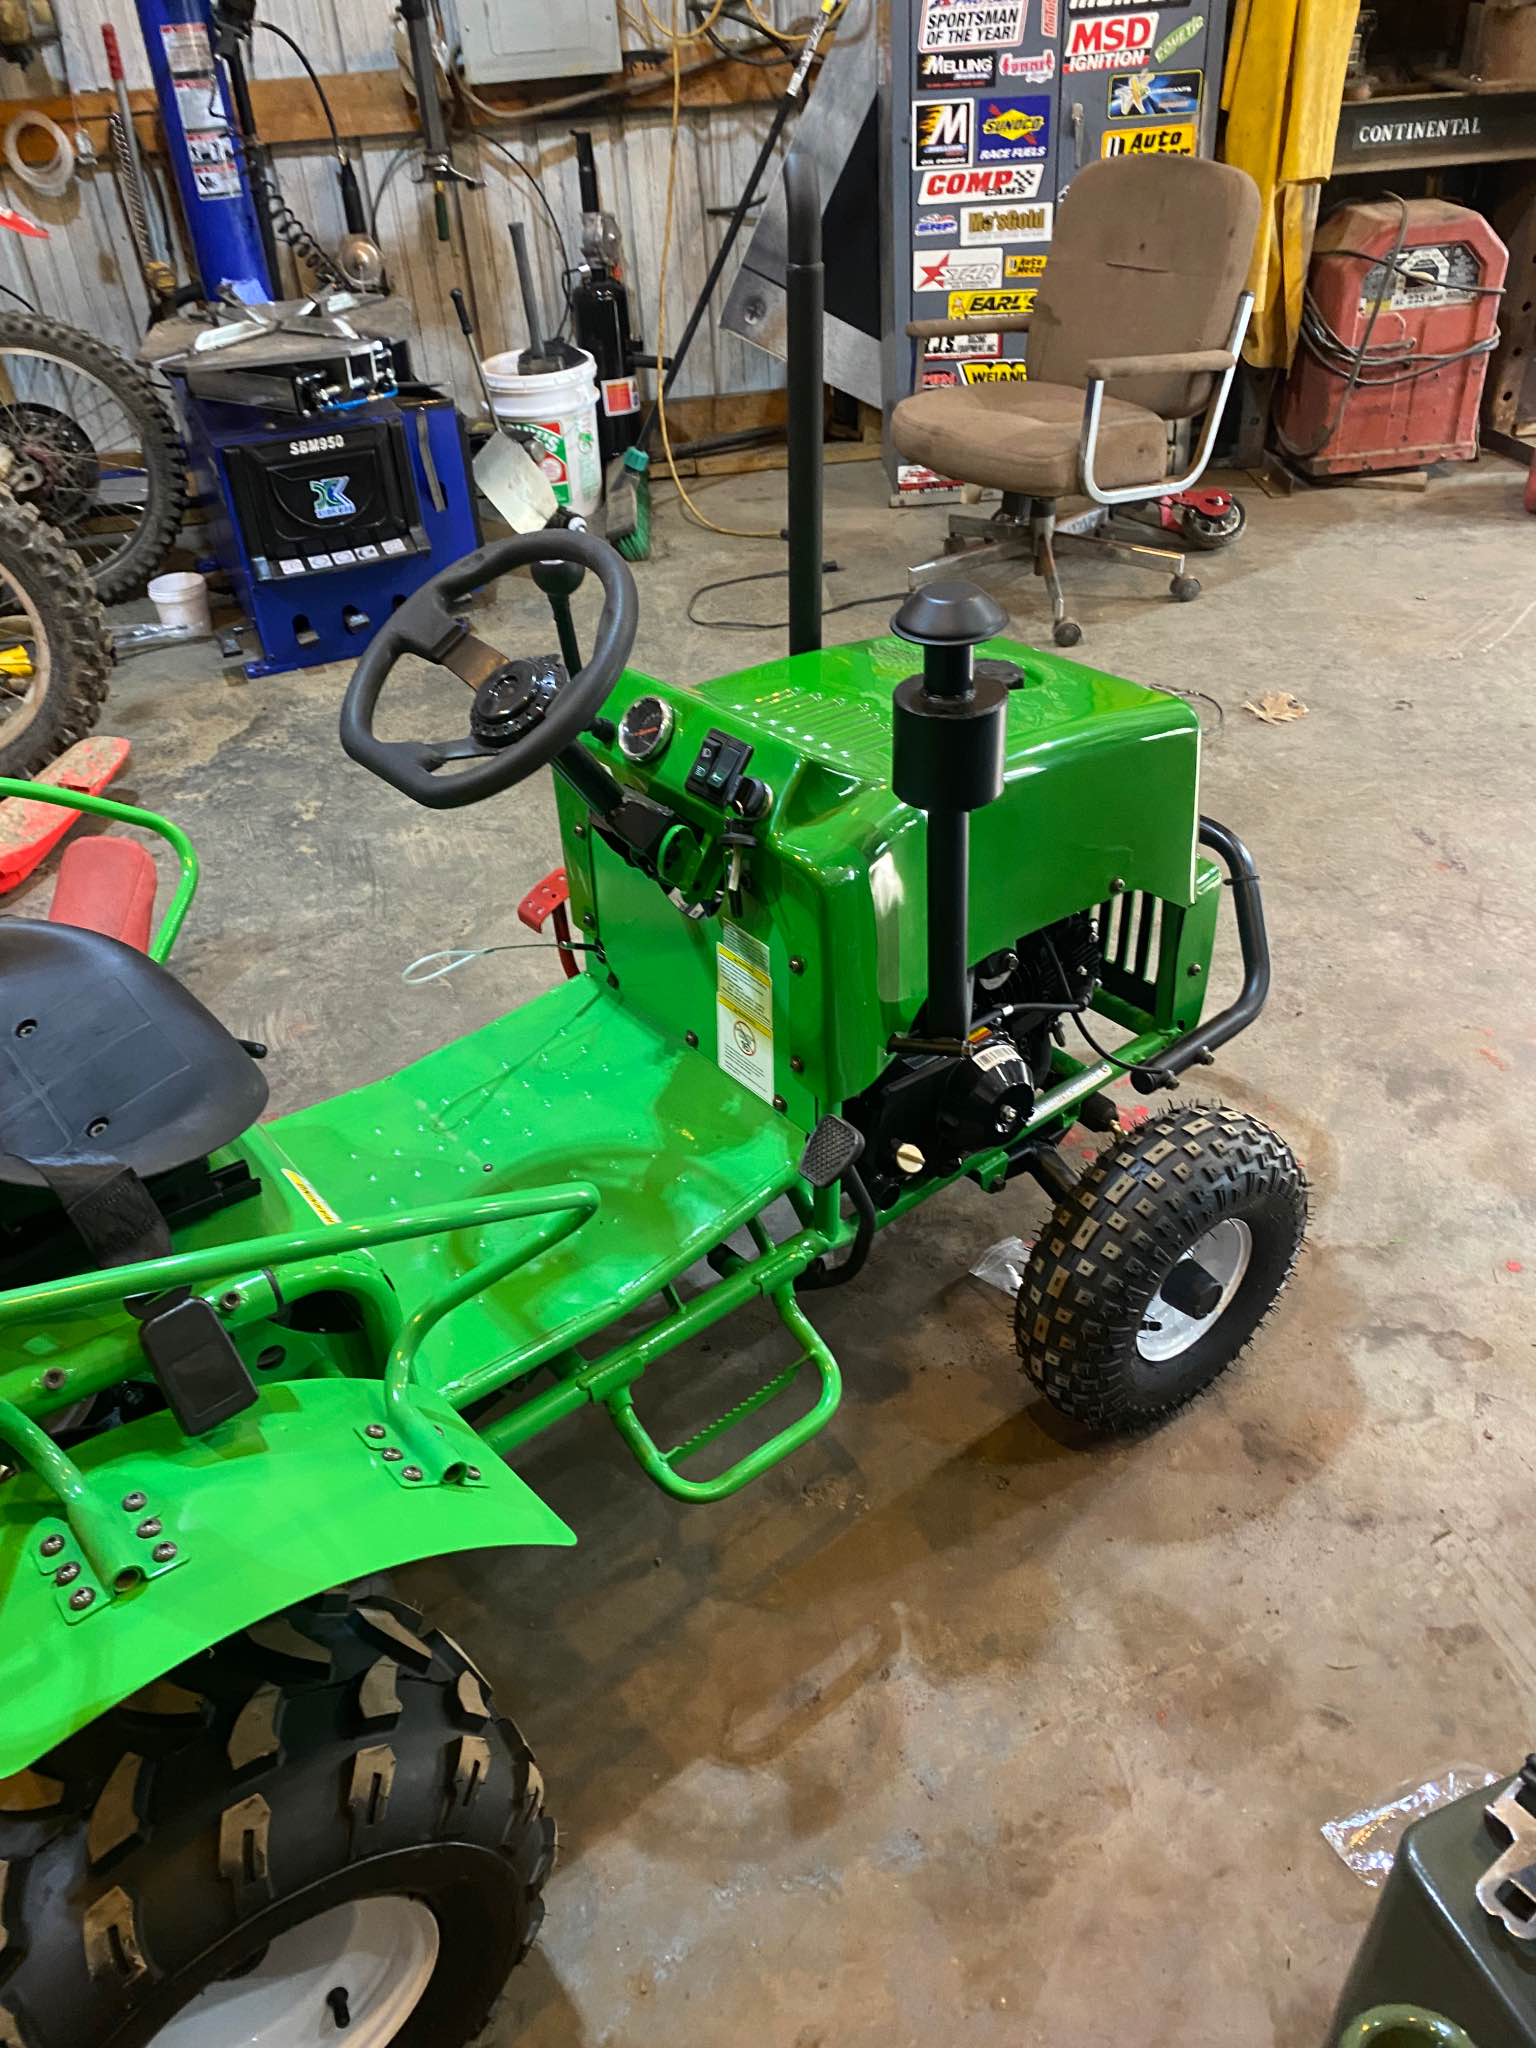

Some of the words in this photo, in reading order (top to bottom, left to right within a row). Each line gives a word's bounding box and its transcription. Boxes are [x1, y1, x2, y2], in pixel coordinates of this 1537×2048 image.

[927, 8, 1018, 29] SPORTSMAN
[926, 31, 944, 45] OF
[949, 28, 972, 42] THE
[977, 25, 1016, 40] YEAR!
[1071, 17, 1151, 54] MSD
[922, 55, 993, 75] MELLING
[1069, 49, 1145, 72] IGNITION
[985, 117, 1043, 133] SUNOCO
[1359, 117, 1480, 142] CONTINENTAL
[1130, 131, 1182, 150] Auto
[927, 170, 1014, 196] COMP
[985, 187, 1025, 196] CAMS
[290, 435, 344, 455] SBM950
